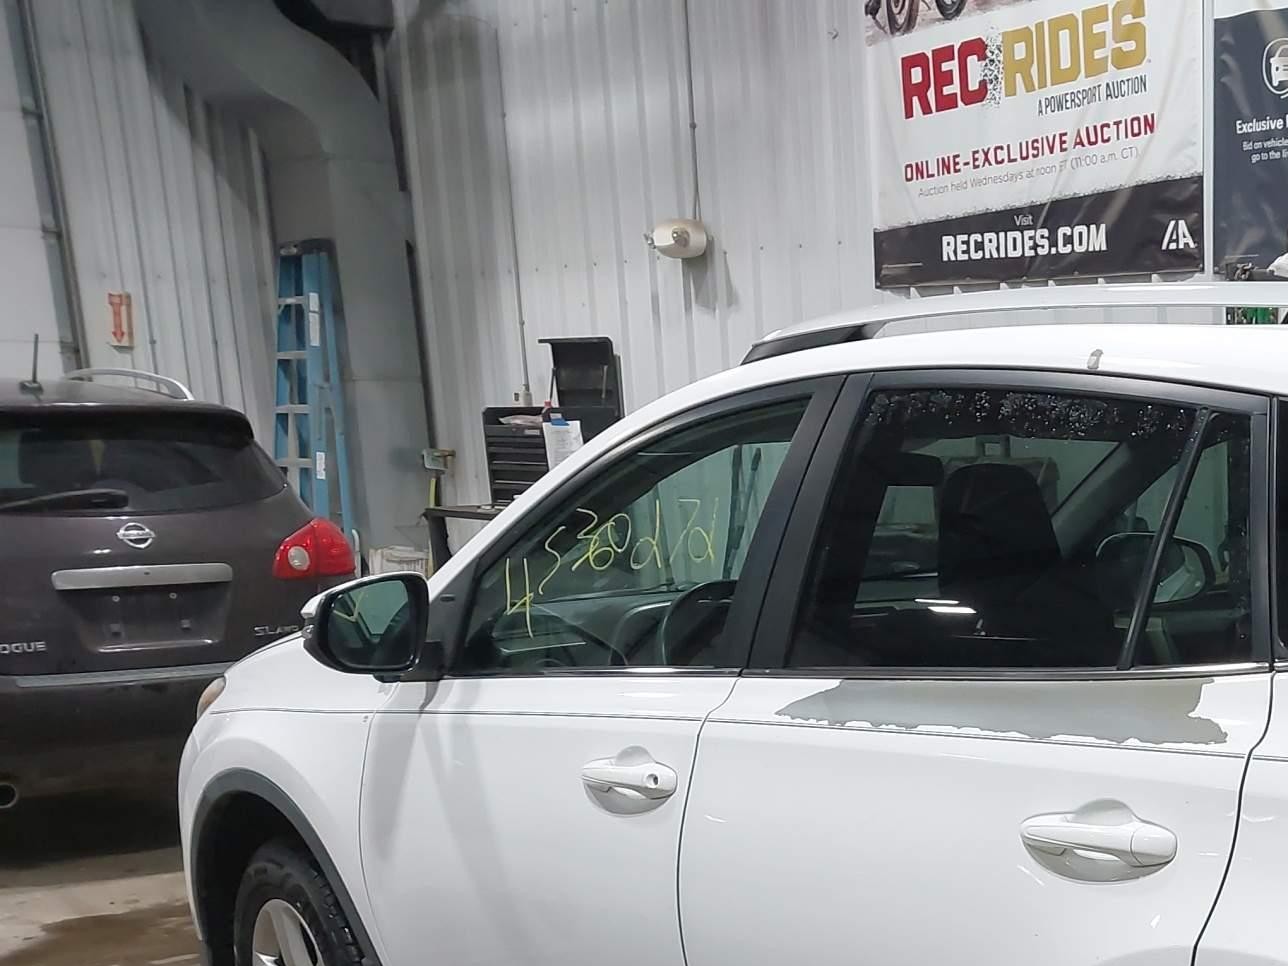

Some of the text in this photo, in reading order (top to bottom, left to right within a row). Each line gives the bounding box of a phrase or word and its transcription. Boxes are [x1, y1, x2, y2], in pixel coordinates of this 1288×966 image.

[901, 0, 1147, 120] REC RIDES
[1037, 74, 1147, 116] A POWERSPORT AUCTION
[1235, 116, 1284, 134] Exclusive
[904, 113, 1156, 183] ONLINE-EXCLUSIVE AUCTION
[1250, 154, 1261, 164] go
[1260, 152, 1268, 161] to
[1268, 150, 1281, 160] the
[1253, 140, 1262, 149] on
[918, 184, 949, 197] Auction
[950, 180, 968, 192] held
[969, 170, 1024, 188] Wednesdays
[1025, 169, 1035, 179] at
[1035, 164, 1057, 176] noon
[1013, 214, 1034, 226] Visit
[942, 223, 1108, 262] RECRIDES.COM
